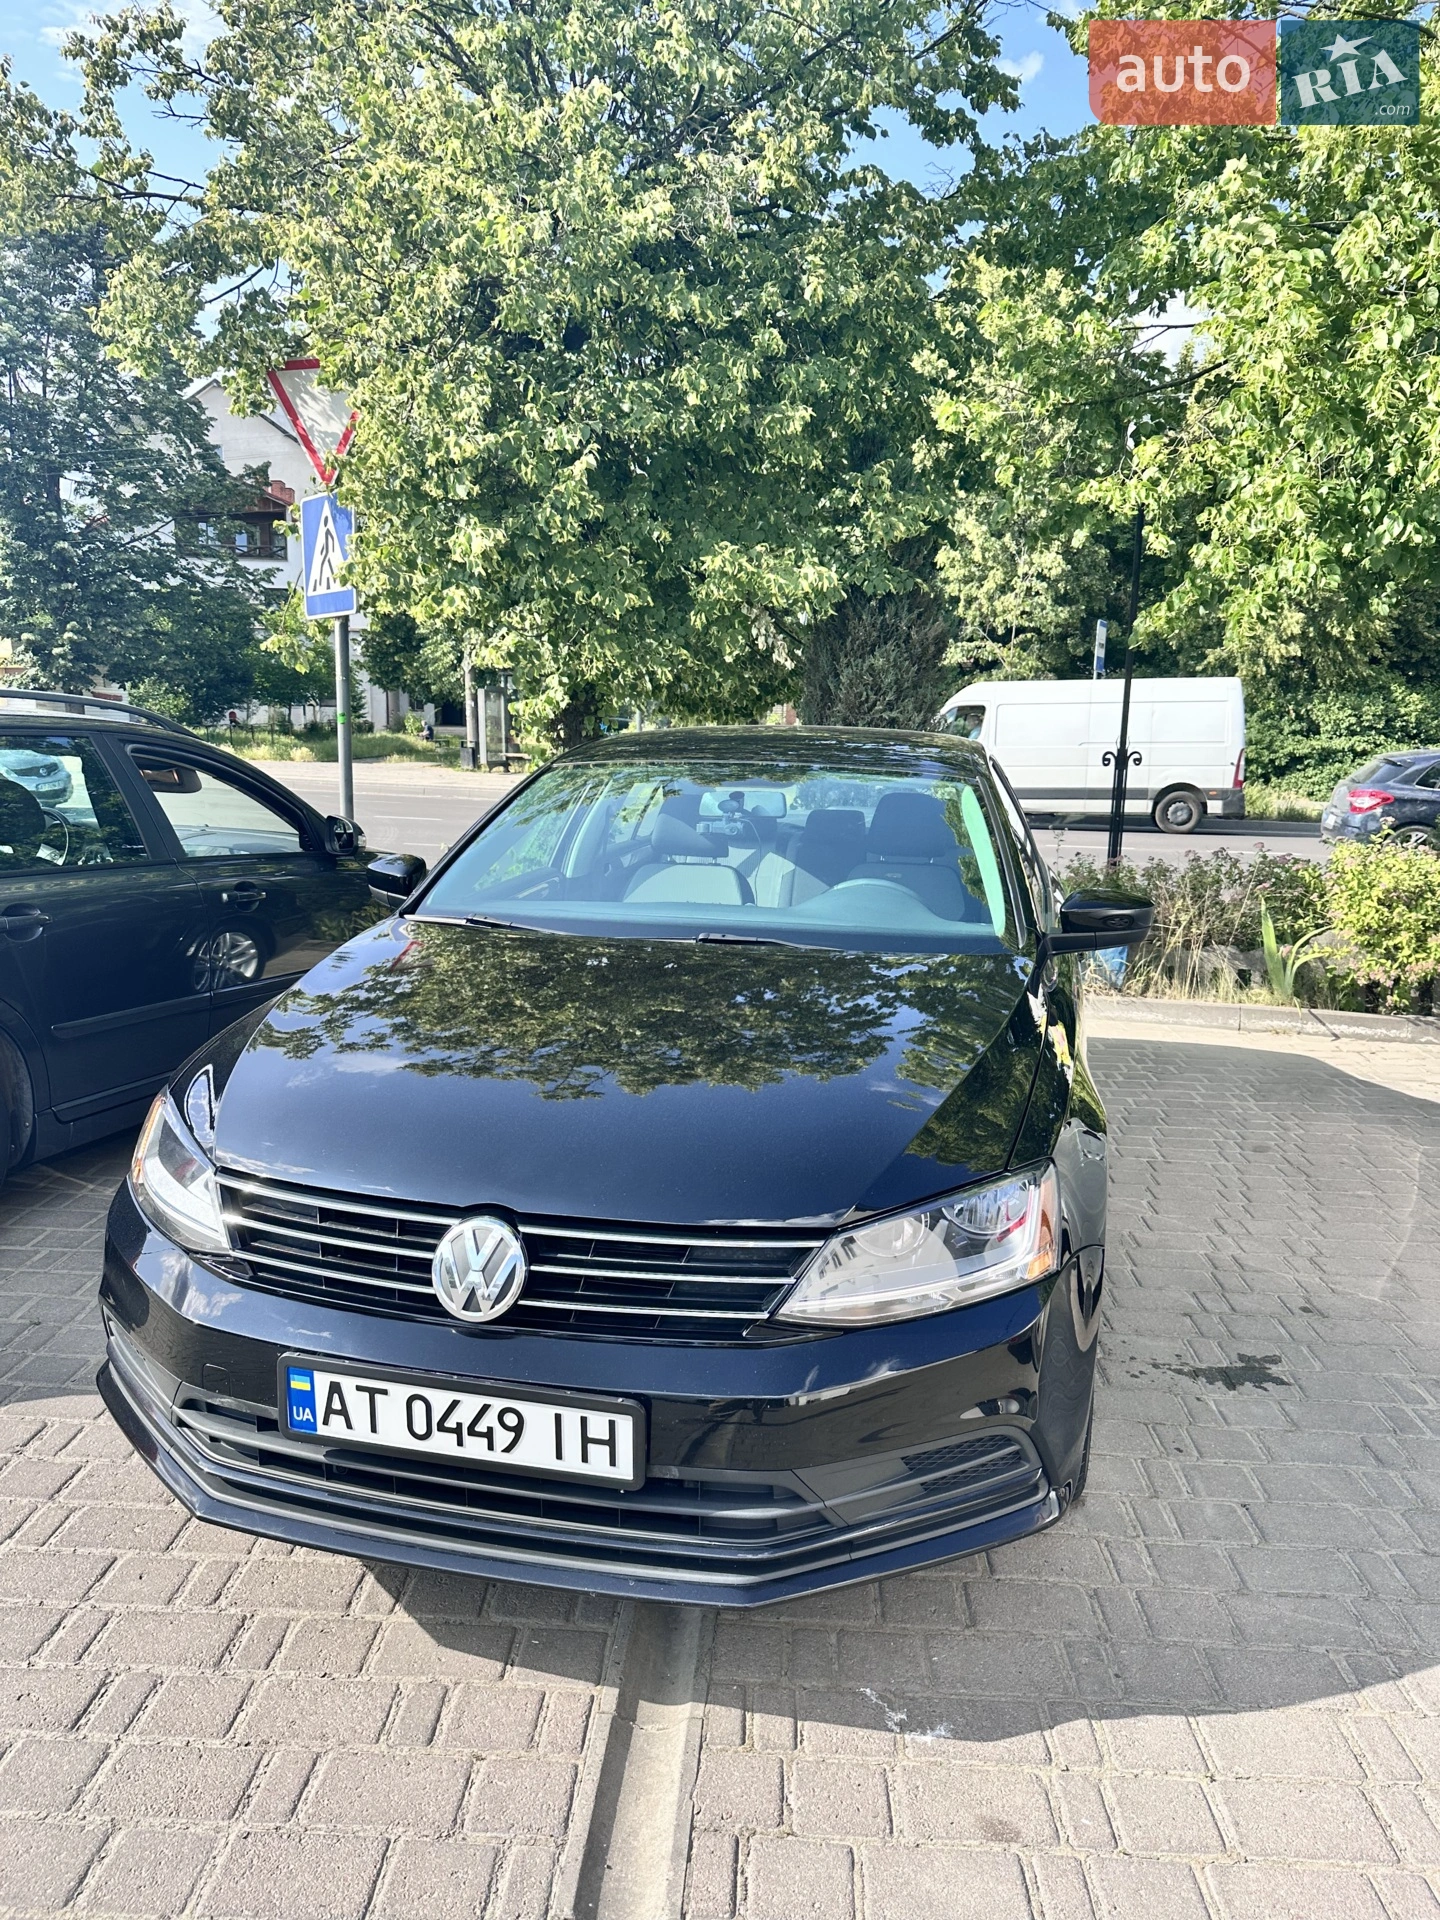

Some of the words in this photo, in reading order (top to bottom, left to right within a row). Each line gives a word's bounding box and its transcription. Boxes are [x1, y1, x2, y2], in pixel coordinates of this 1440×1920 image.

[293, 1406, 313, 1422] UA
[322, 1381, 389, 1434] AT
[406, 1393, 525, 1453] 0449
[554, 1413, 617, 1467] IH
